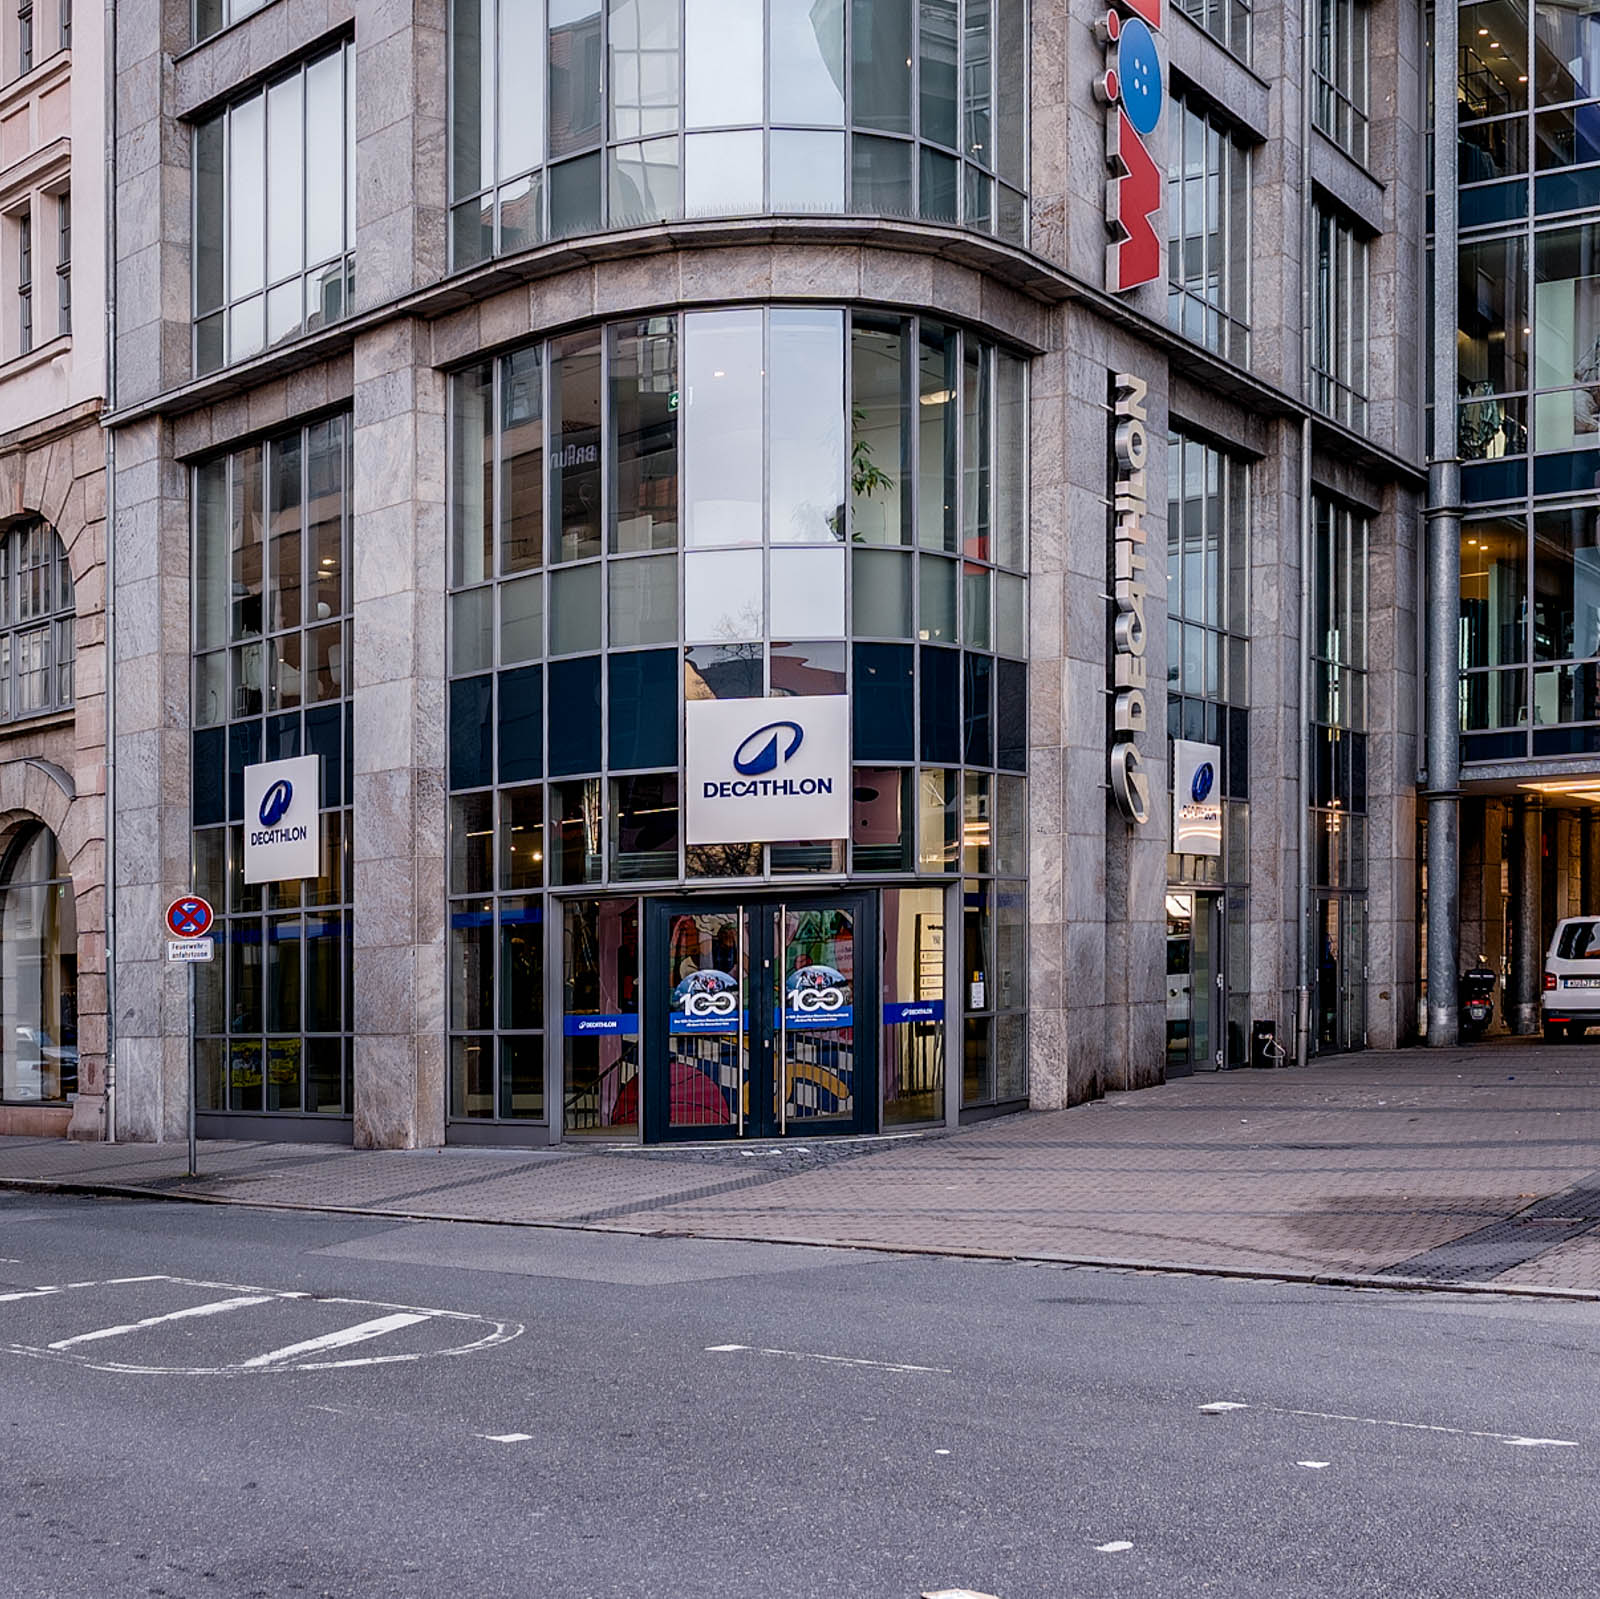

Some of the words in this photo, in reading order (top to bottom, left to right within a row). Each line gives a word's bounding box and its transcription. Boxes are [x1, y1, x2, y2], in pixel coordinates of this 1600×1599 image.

[1113, 372, 1149, 733] DECATHLON
[702, 776, 833, 798] DECATHLON
[251, 825, 307, 847] DECATHLON
[679, 992, 737, 1016] 100
[787, 987, 844, 1012] 100
